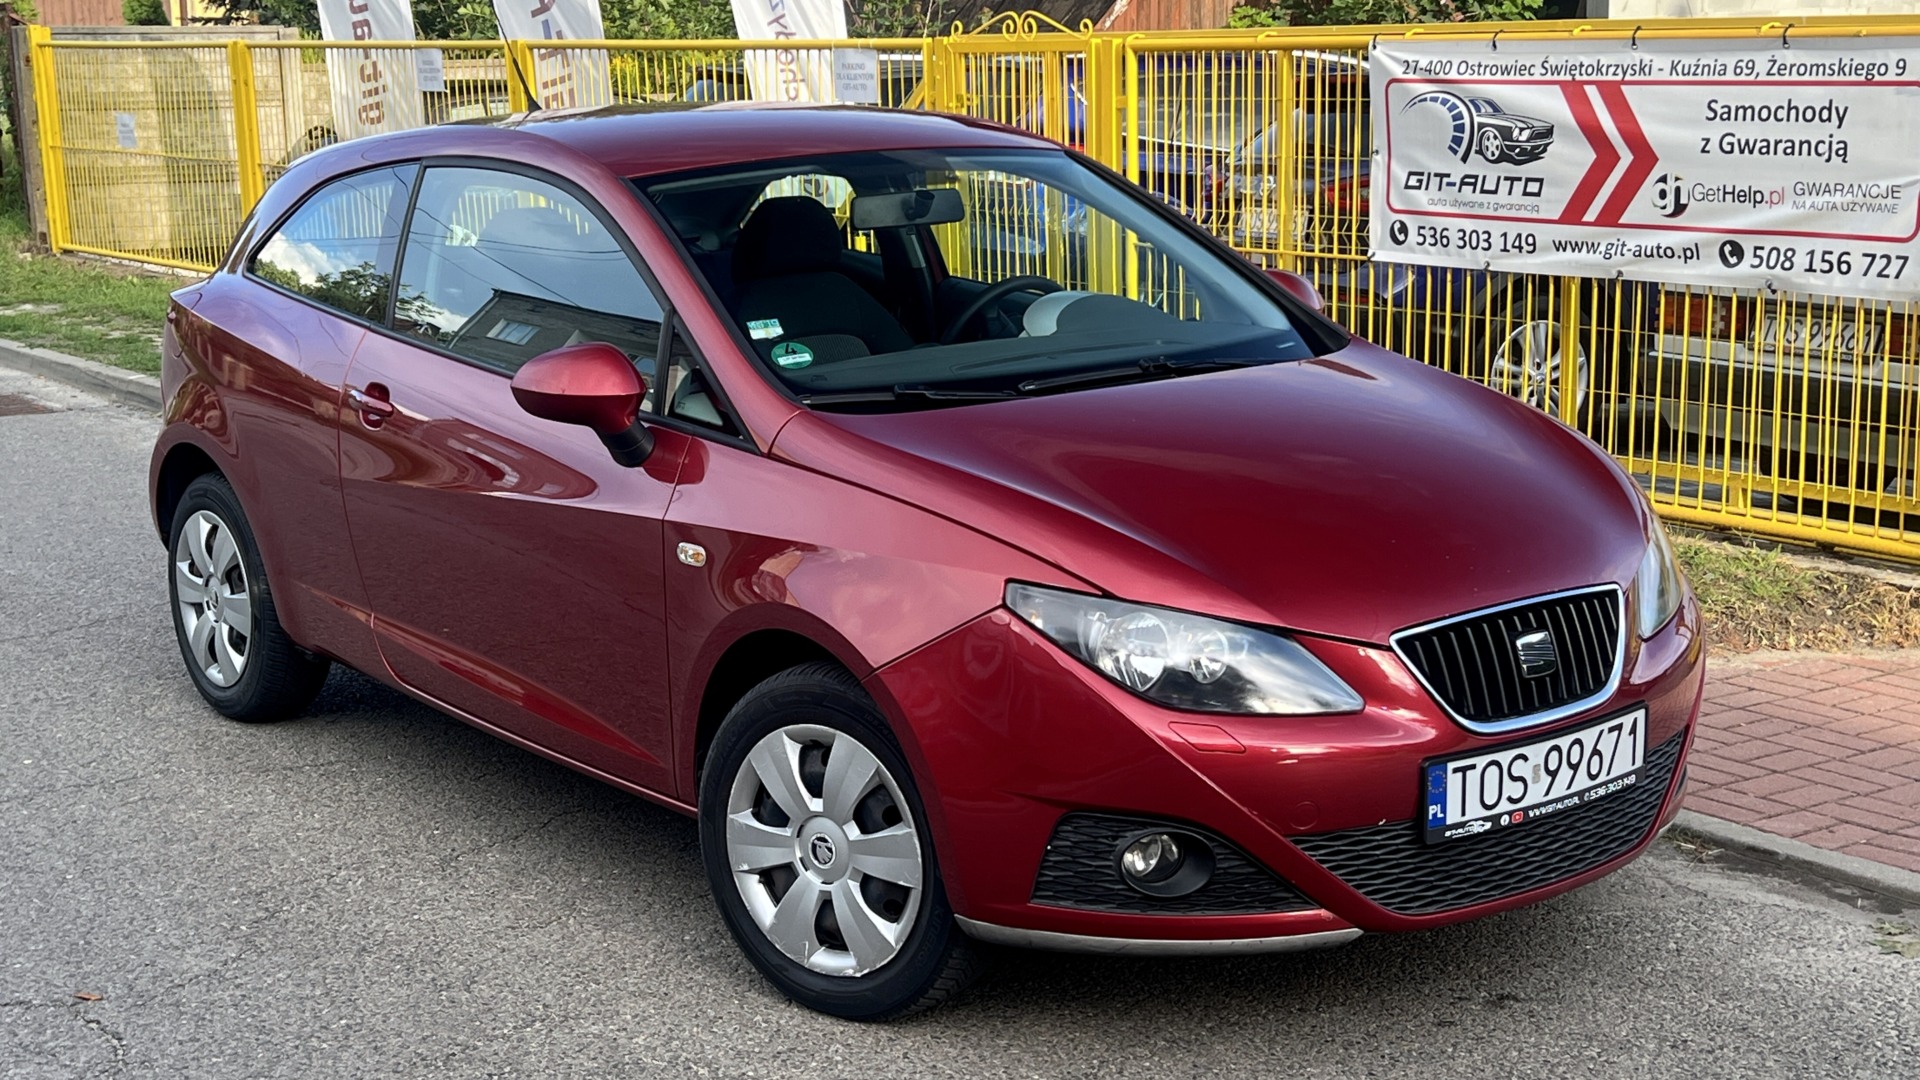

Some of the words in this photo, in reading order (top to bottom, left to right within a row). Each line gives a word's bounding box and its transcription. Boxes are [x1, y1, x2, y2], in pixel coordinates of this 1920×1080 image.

[1402, 59, 1453, 76] 27-400
[1456, 59, 1536, 77] Ostrowiec
[1539, 55, 1653, 81] Świętokrzyski
[1669, 58, 1728, 77] Kuźnia
[1733, 59, 1760, 79] 69,
[1766, 55, 1889, 81] Żeromskiego
[1895, 58, 1907, 77] 9
[1705, 98, 1849, 129] Samochody
[1700, 137, 1711, 154] z
[1718, 132, 1849, 163] Gwarancją
[1403, 171, 1545, 198] GIT-AUTO
[1691, 182, 1785, 209] GetHelp.pl
[1793, 181, 1902, 200] GWARANCJE
[1427, 197, 1447, 207] auta
[1449, 198, 1485, 210] używane
[1492, 201, 1541, 214] gwarancją
[1791, 201, 1807, 211] NA
[1808, 201, 1839, 212] AUTA
[1841, 199, 1900, 215] UŻYWANE
[1416, 225, 1450, 249] 536
[1456, 228, 1493, 252] 303
[1499, 231, 1537, 255] 149
[1552, 238, 1701, 264] www.git-auto.pl
[1749, 245, 1796, 272] 508
[1803, 249, 1851, 276] 156
[1861, 252, 1910, 280] 727
[1452, 752, 1530, 818] TOS
[1543, 716, 1639, 798] 99671
[1428, 803, 1445, 820] PL
